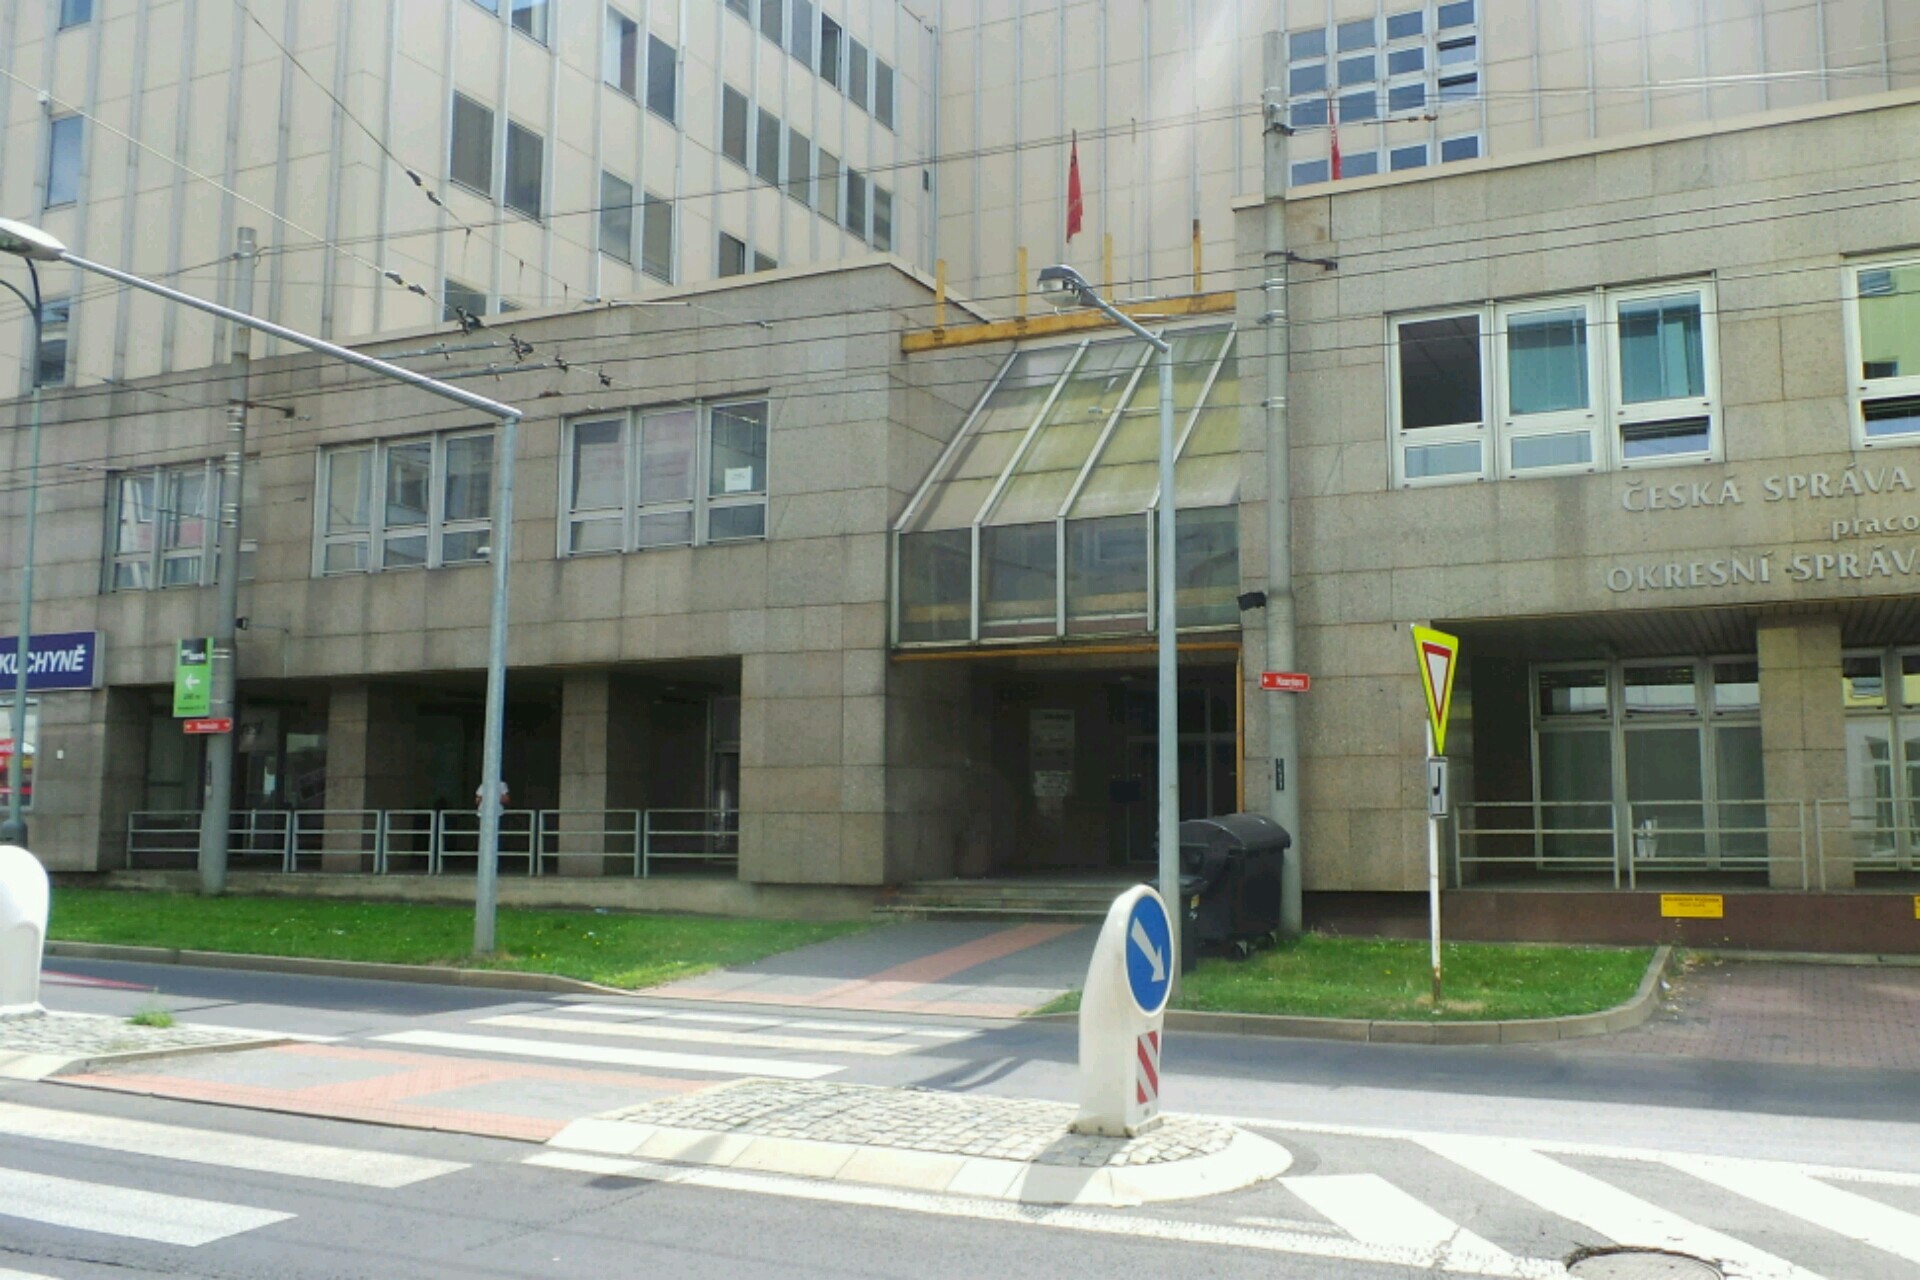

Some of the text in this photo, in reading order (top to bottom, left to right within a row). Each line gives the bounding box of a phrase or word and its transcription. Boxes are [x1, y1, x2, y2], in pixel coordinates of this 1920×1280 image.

[1622, 463, 1916, 512] ČESKÁ SPRÁVA
[1831, 514, 1920, 542] praco
[1607, 544, 1920, 592] OKRESNÍ SPRÁV
